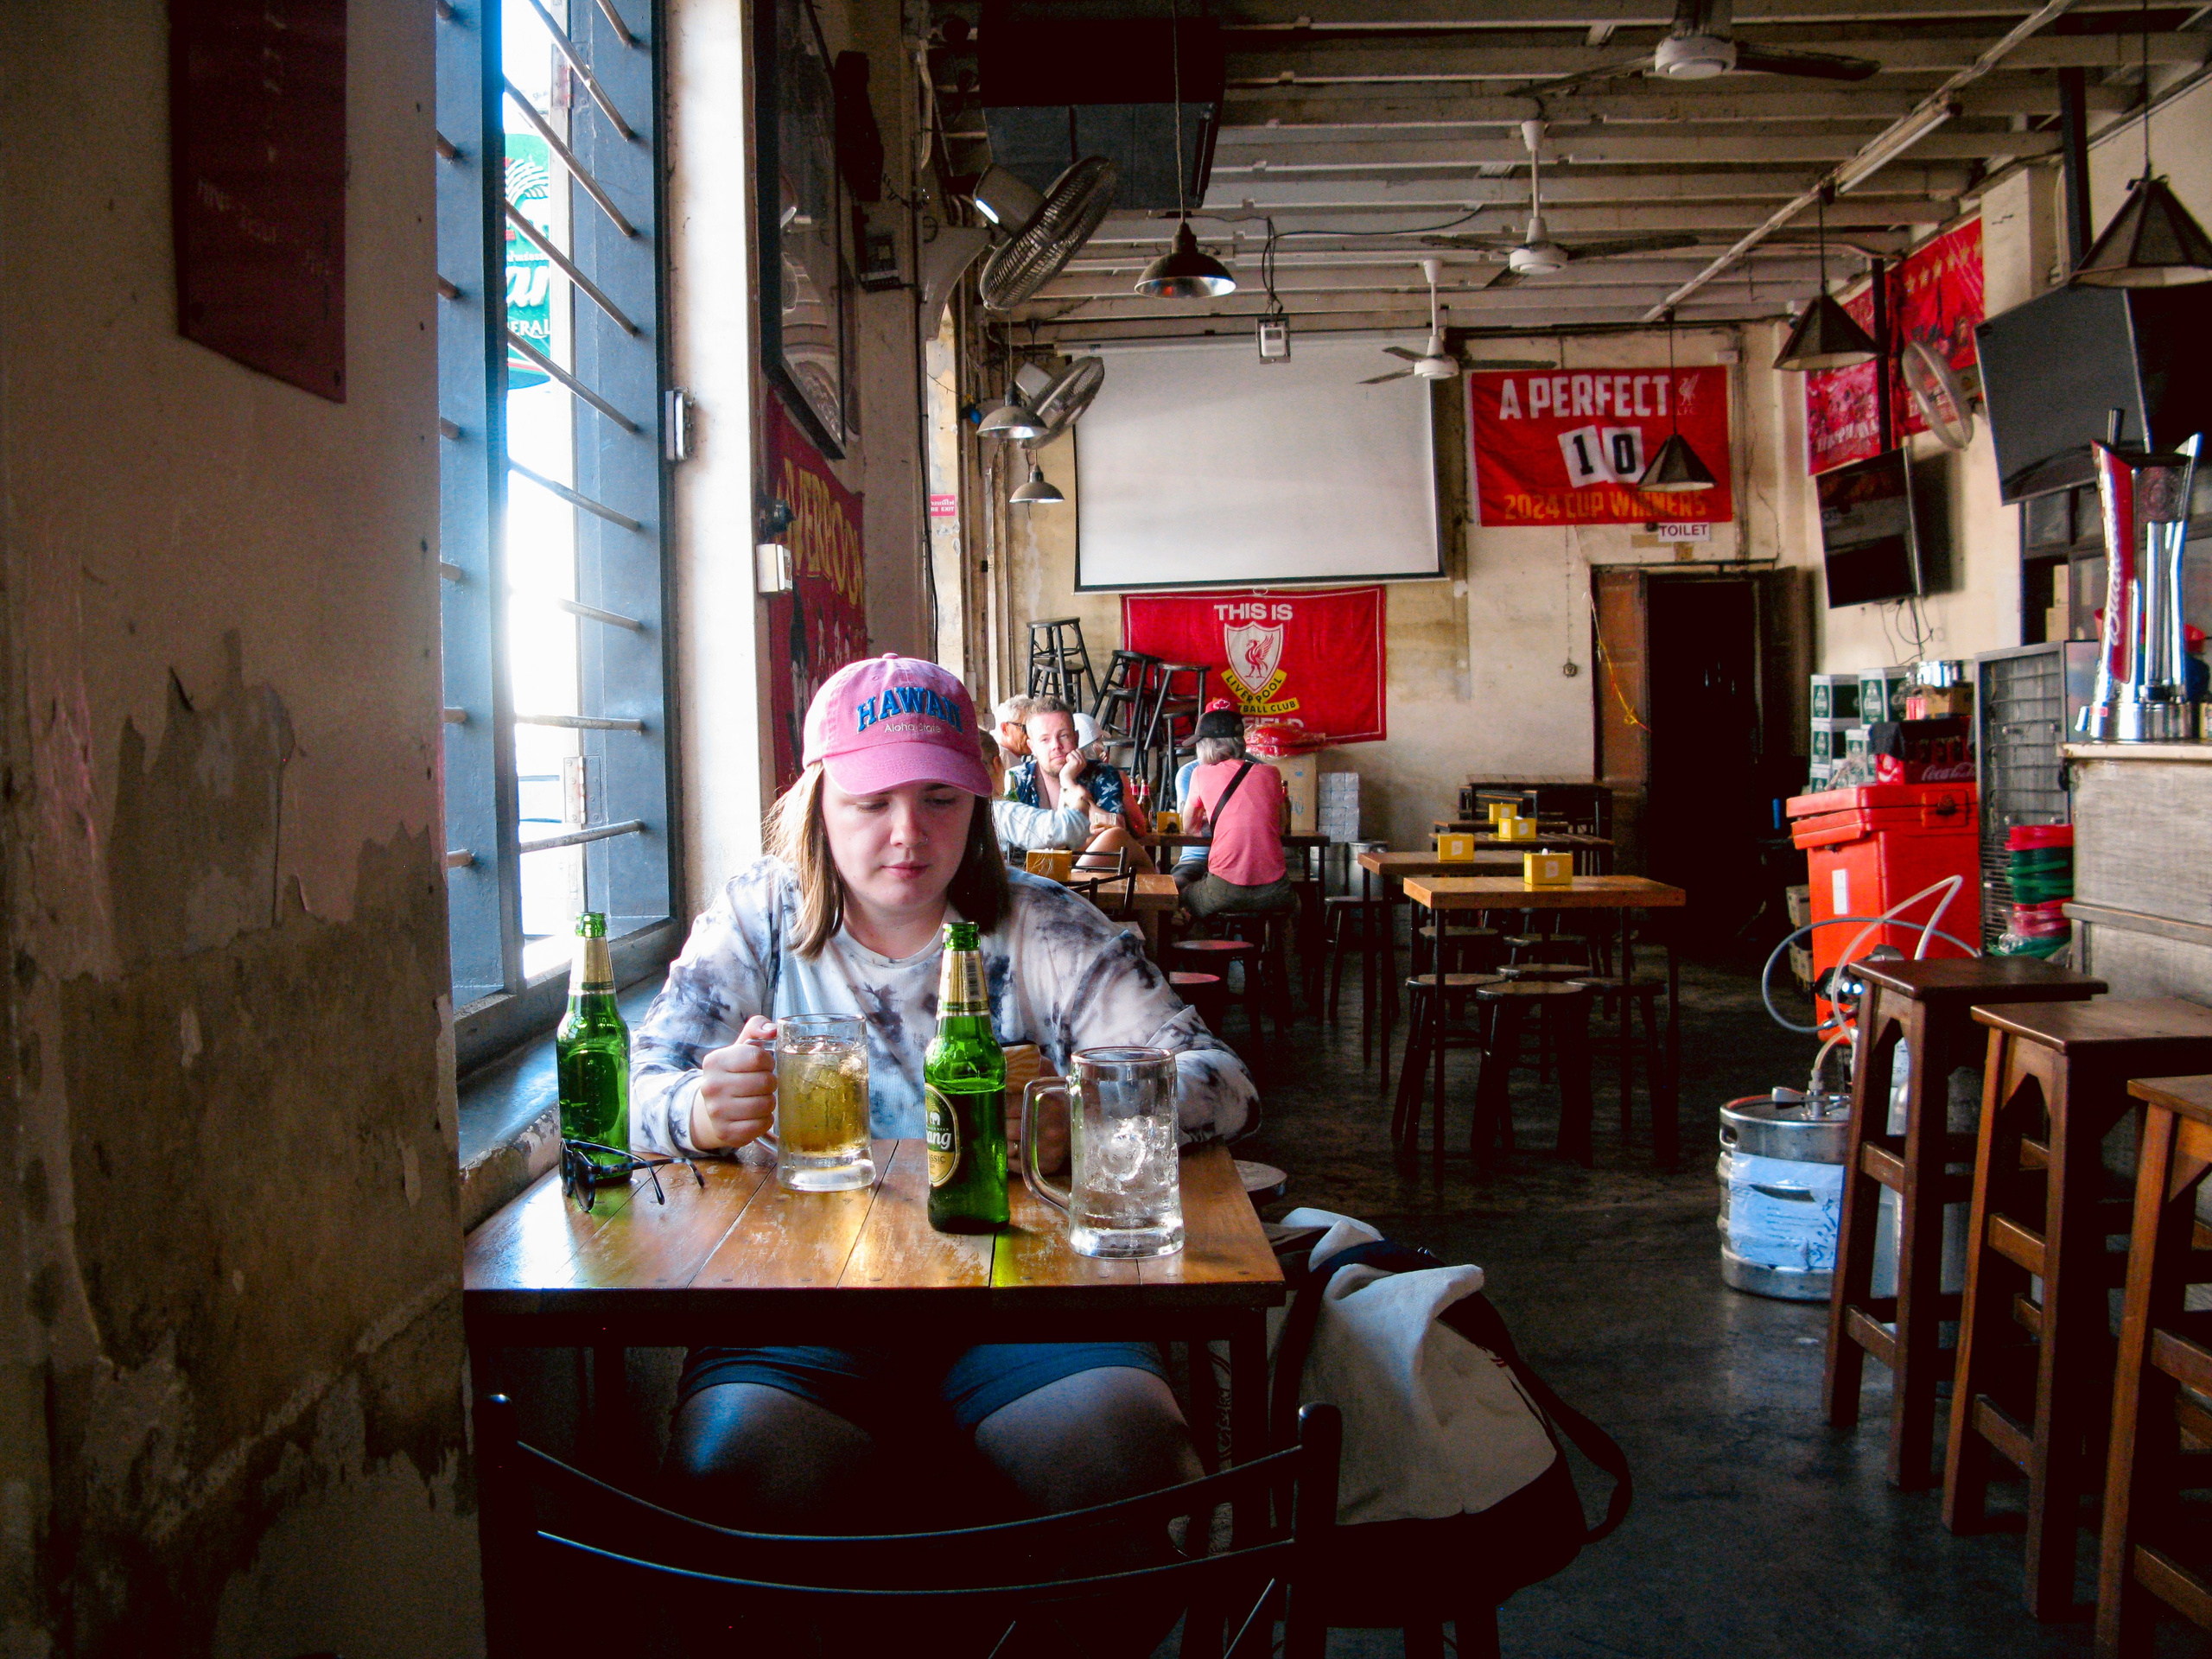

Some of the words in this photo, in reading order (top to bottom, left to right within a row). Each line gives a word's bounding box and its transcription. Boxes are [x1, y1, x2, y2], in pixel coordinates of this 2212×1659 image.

[1499, 378, 1522, 421] A
[1528, 375, 1671, 419] PERFECT
[1503, 493, 1560, 520] 2024
[1565, 491, 1605, 518] CUP
[1659, 523, 1708, 537] TOILET
[1213, 602, 1267, 621] THIS
[1271, 603, 1294, 620] IS
[1225, 674, 1282, 704] LIVERPOOL
[856, 686, 964, 734] HAWAII
[1270, 701, 1296, 712] CLUB
[884, 721, 915, 734] Aloha
[918, 722, 942, 734] State
